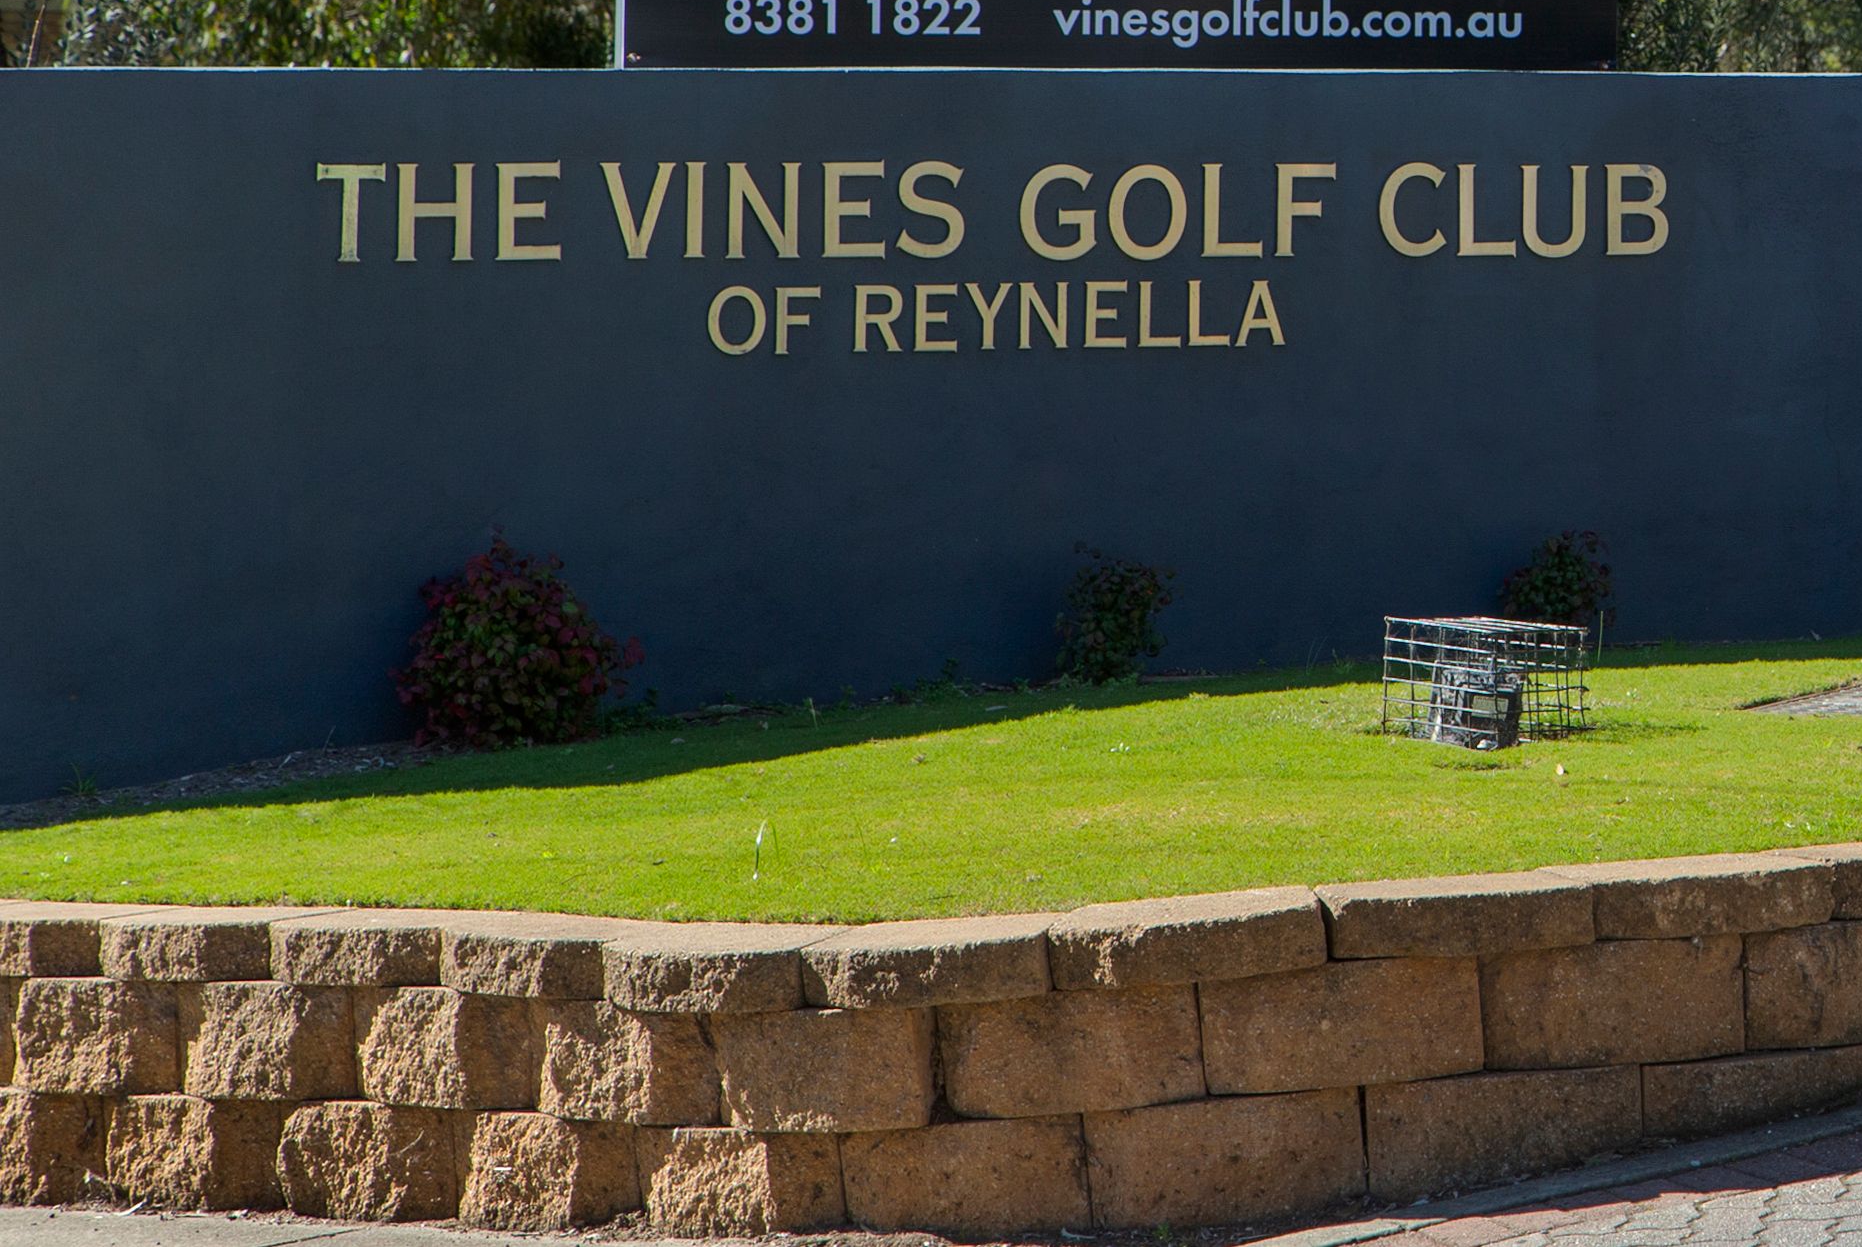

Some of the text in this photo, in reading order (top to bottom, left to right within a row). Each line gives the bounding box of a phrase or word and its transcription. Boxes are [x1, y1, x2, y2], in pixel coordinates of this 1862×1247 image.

[315, 159, 1671, 263] THE VINES GOLF CLUB
[706, 279, 1287, 356] OF REYNELLA
